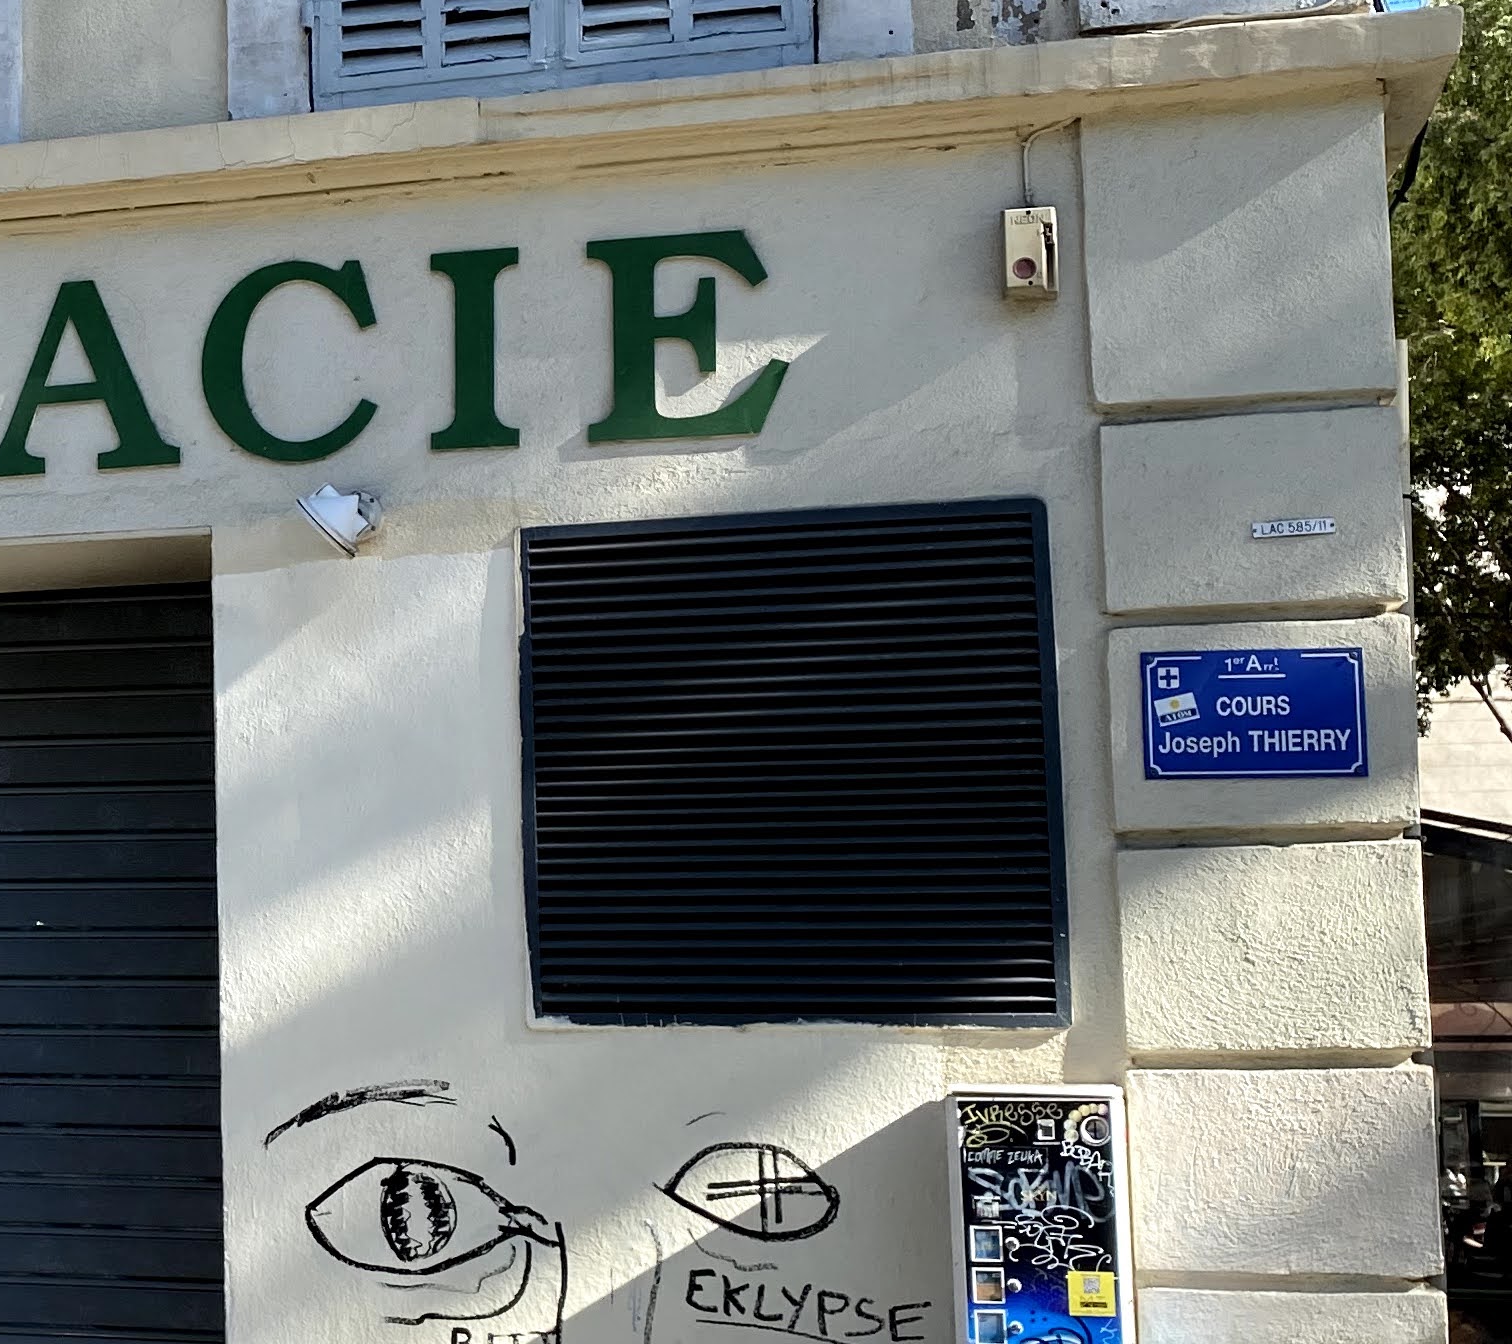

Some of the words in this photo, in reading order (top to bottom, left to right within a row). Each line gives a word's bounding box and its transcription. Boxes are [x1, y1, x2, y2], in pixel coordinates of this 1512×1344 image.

[1261, 523, 1284, 535] LAC
[1224, 657, 1245, 672] 1er
[1215, 696, 1290, 717] COURS
[1158, 731, 1240, 758] Joseph
[1248, 729, 1351, 753] THIERRY
[685, 1268, 932, 1343] EKLYPSE
